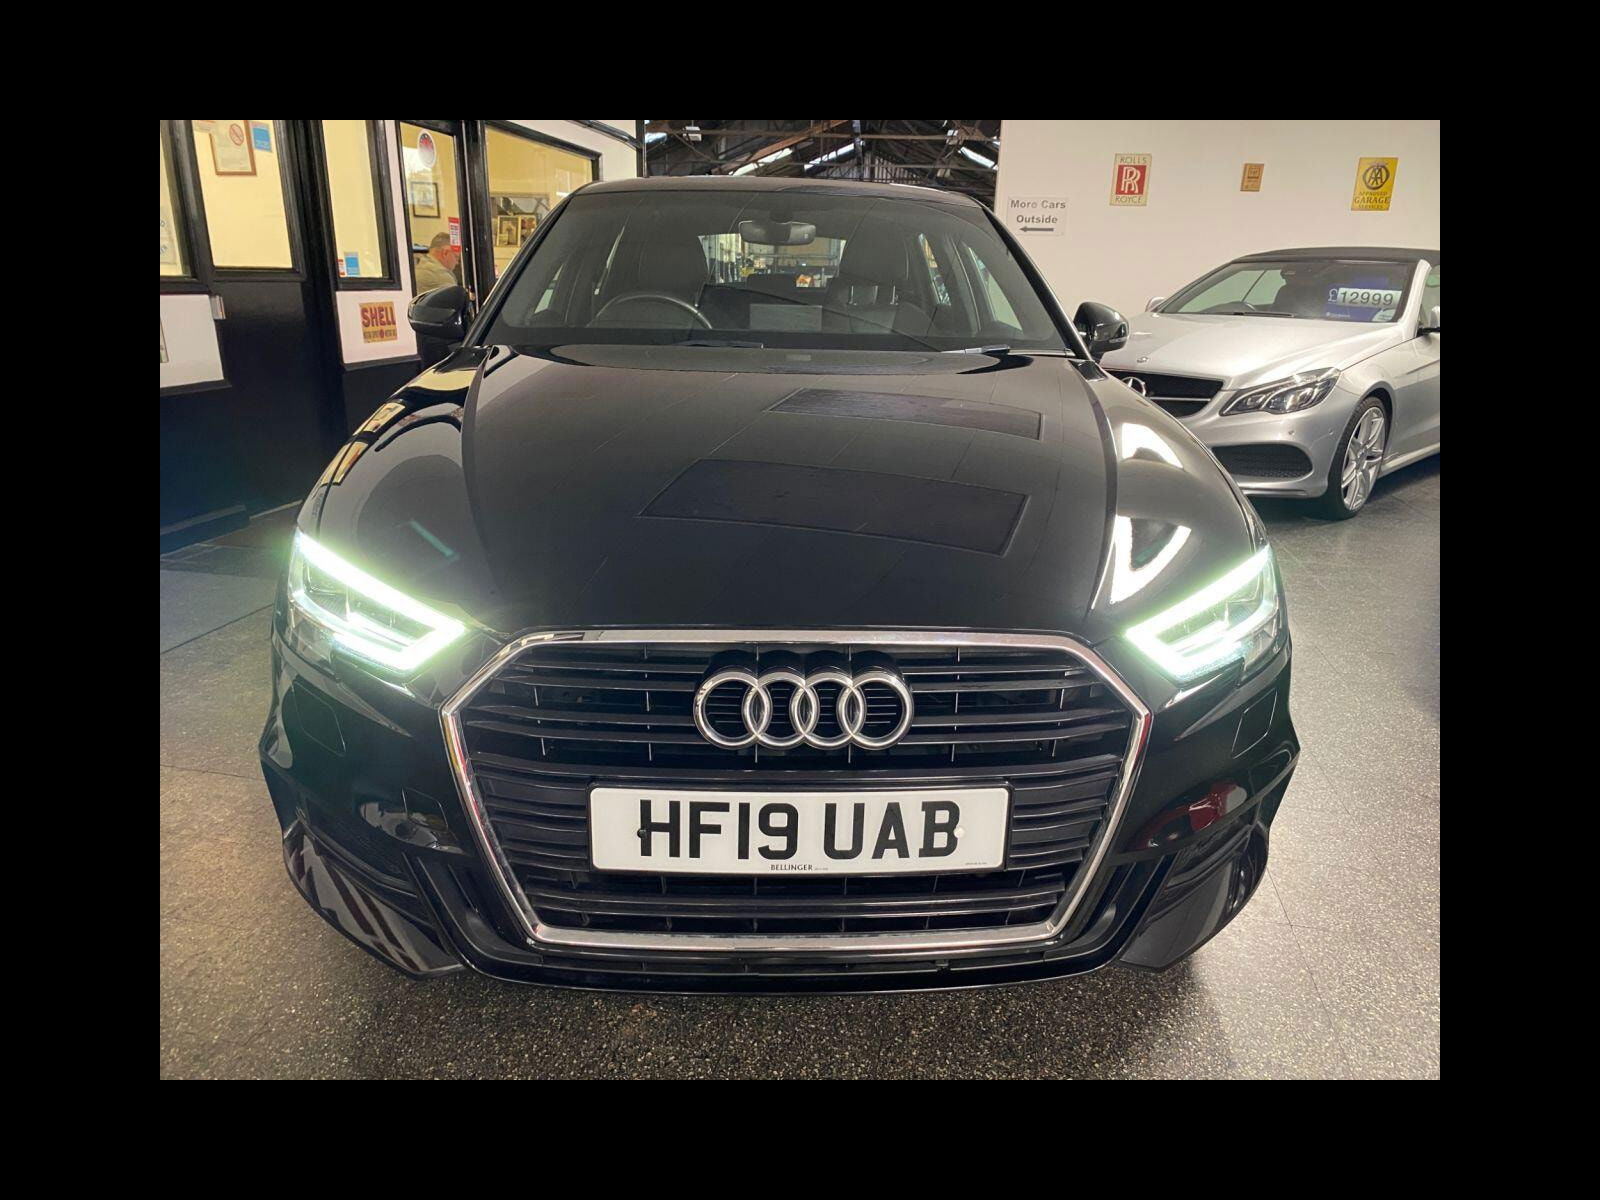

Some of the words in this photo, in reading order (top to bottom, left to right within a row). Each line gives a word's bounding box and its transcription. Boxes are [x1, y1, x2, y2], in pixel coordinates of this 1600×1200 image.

[1119, 156, 1147, 164] ROLLS
[1010, 199, 1038, 209] More
[1041, 199, 1066, 209] Cars
[1115, 195, 1144, 204] ROYCE
[1354, 196, 1389, 204] GARAGE
[1016, 214, 1058, 224] Outside
[1327, 288, 1394, 306] £12999
[361, 306, 397, 328] SHELL
[638, 799, 799, 860] HF19
[823, 800, 961, 860] UAB
